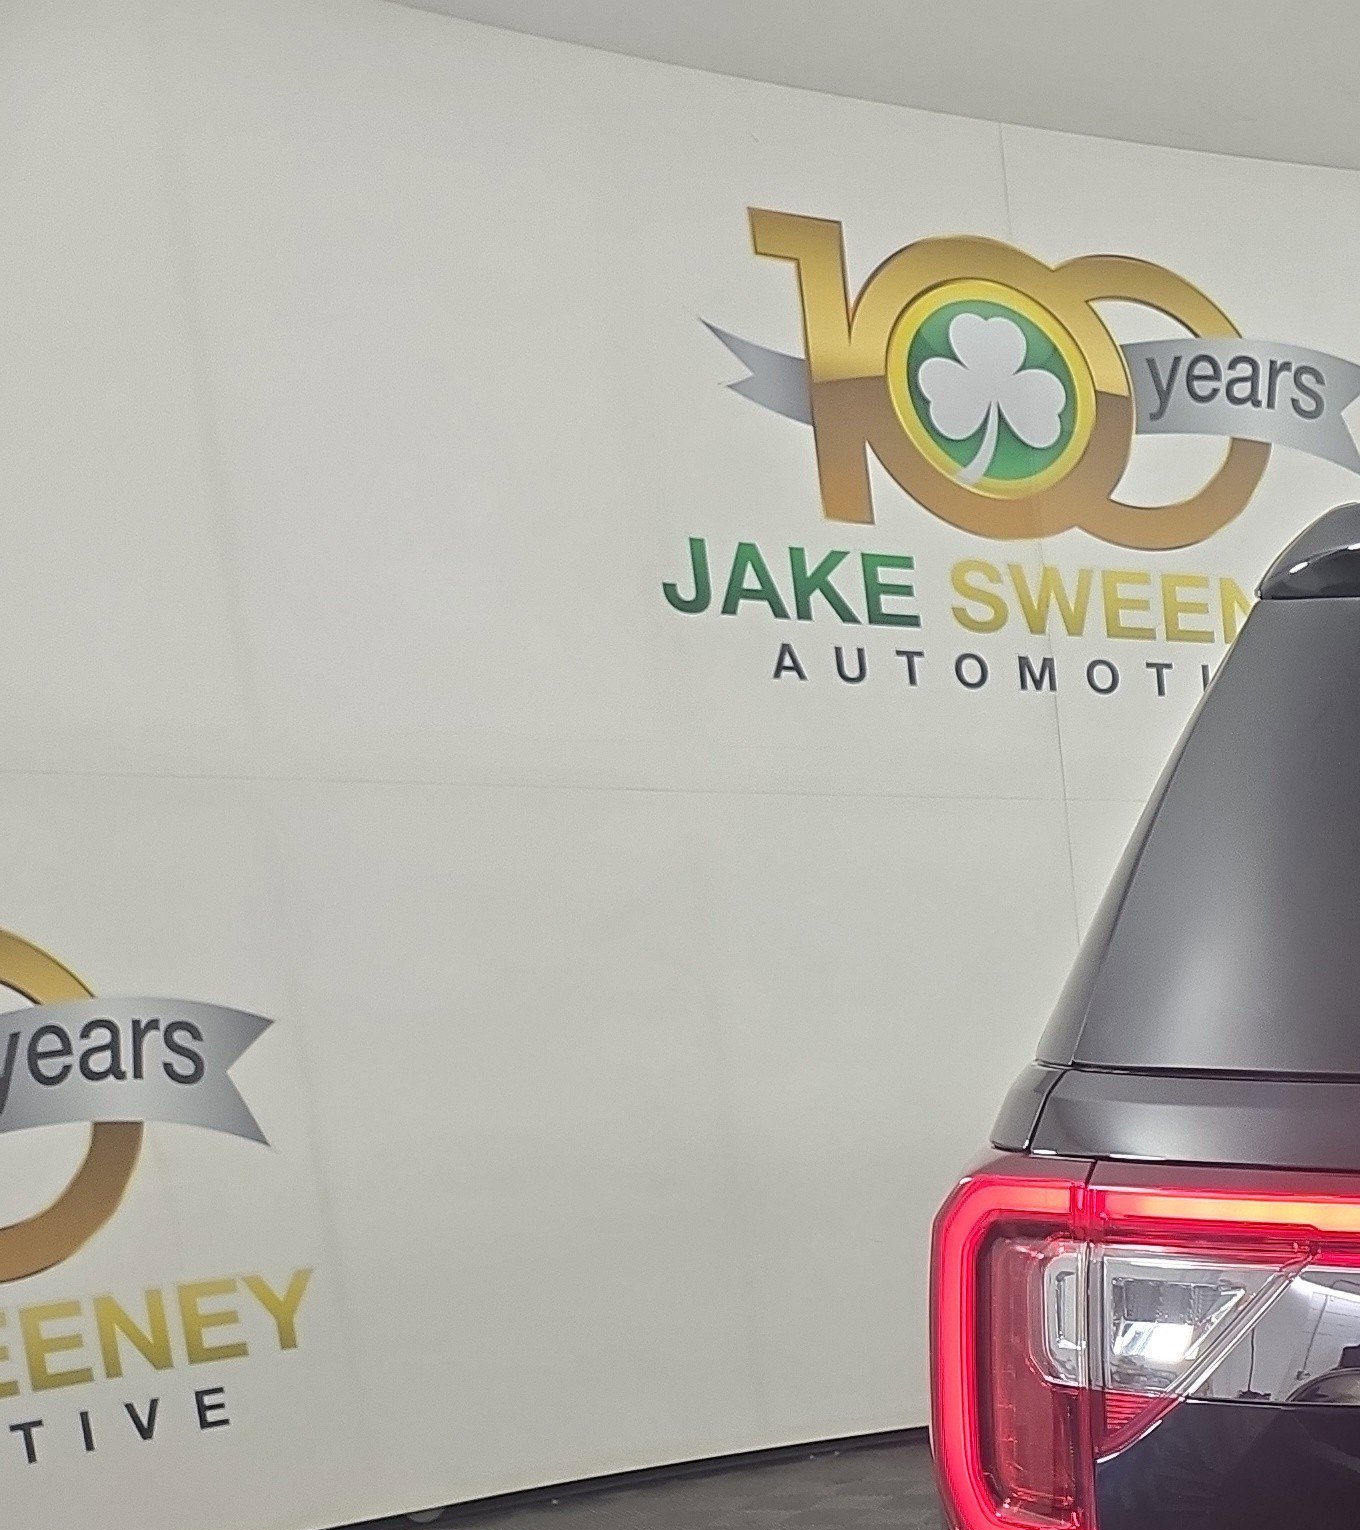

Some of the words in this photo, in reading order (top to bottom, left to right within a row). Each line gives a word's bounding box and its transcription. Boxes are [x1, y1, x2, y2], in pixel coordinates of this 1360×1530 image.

[1144, 350, 1329, 422] years
[661, 536, 922, 629] JAKE
[9, 1386, 230, 1464] TIVE
